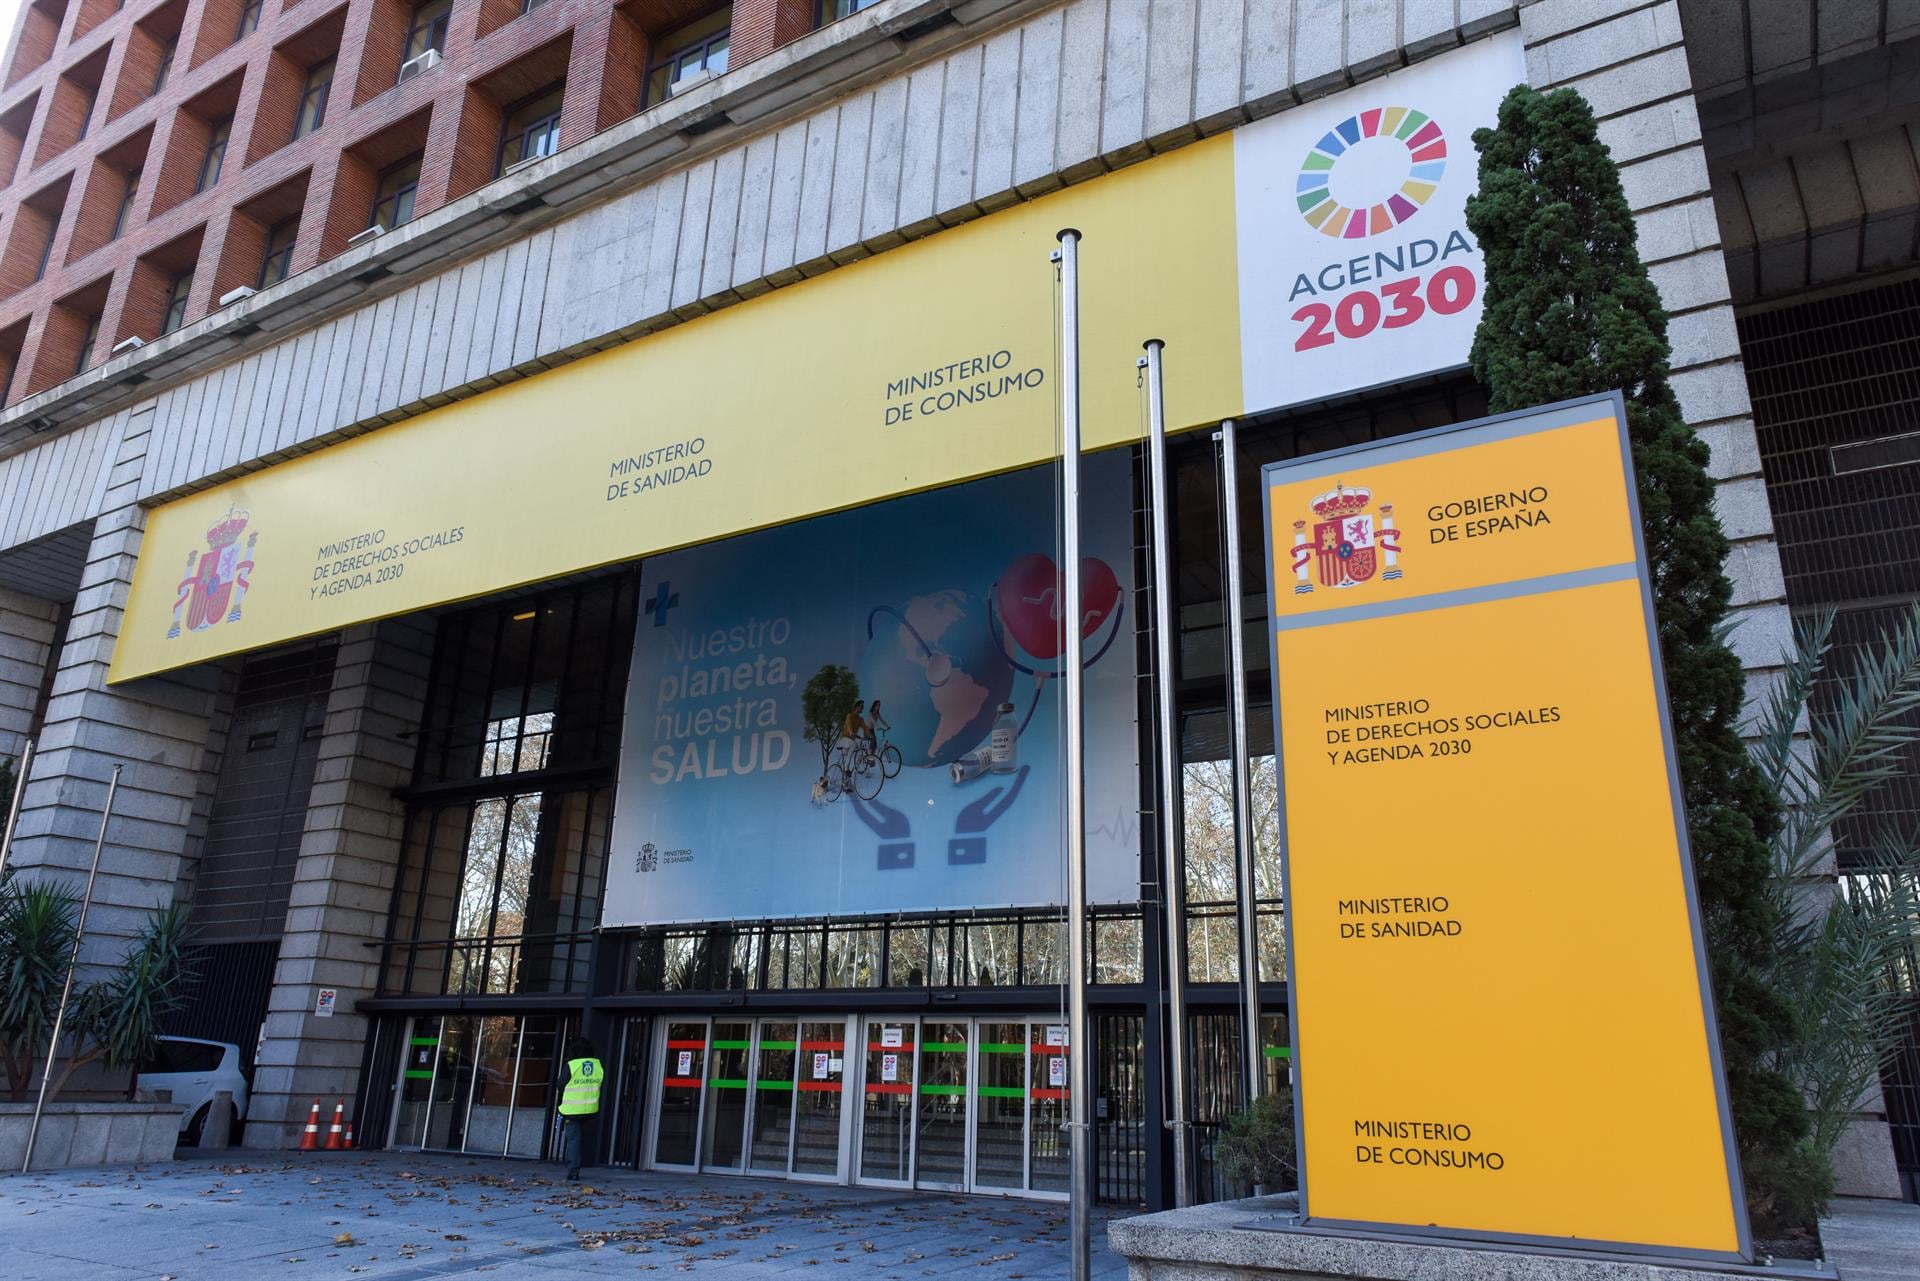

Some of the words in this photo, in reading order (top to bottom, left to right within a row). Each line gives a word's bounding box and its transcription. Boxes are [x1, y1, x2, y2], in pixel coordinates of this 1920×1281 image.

[1288, 229, 1474, 302] AGENDA
[1290, 265, 1477, 353] 2030
[887, 350, 1012, 400] MINISTERIO
[885, 402, 913, 426] DE
[920, 368, 1044, 416] CONSUMO
[610, 437, 705, 478] MINISTERIO
[607, 481, 630, 501] DE
[633, 459, 712, 494] SANIDAD
[1427, 486, 1549, 522] GOBIERNO
[317, 529, 386, 561] MINISTERIO
[1429, 525, 1459, 544] DE
[1465, 508, 1551, 538] ESPAÑA
[313, 564, 331, 581] DE
[332, 545, 399, 576] DERECHOS
[401, 526, 465, 557] SOCIALES
[310, 586, 319, 601] Y
[319, 572, 372, 599] AGENDA
[375, 563, 404, 584] 2030
[663, 617, 790, 665] Nuestro
[657, 653, 798, 713] planeta,
[654, 697, 777, 742] nuestra
[1325, 698, 1430, 723] MINISTERIO
[1326, 729, 1351, 744] DE
[1356, 717, 1460, 742] DERECHOS
[1465, 706, 1561, 731] SOCIALES
[650, 729, 791, 785] SALUD
[1327, 751, 1339, 766] Y
[1343, 744, 1425, 765] AGENDA
[1429, 739, 1472, 757] 2030
[1338, 896, 1449, 915] MINISTERIO
[1340, 923, 1366, 938] DE
[1371, 920, 1462, 938] SANIDAD
[1354, 1119, 1471, 1142] MINISTERIO
[1356, 1146, 1383, 1163] DE
[1389, 1147, 1505, 1170] CONSUMO
